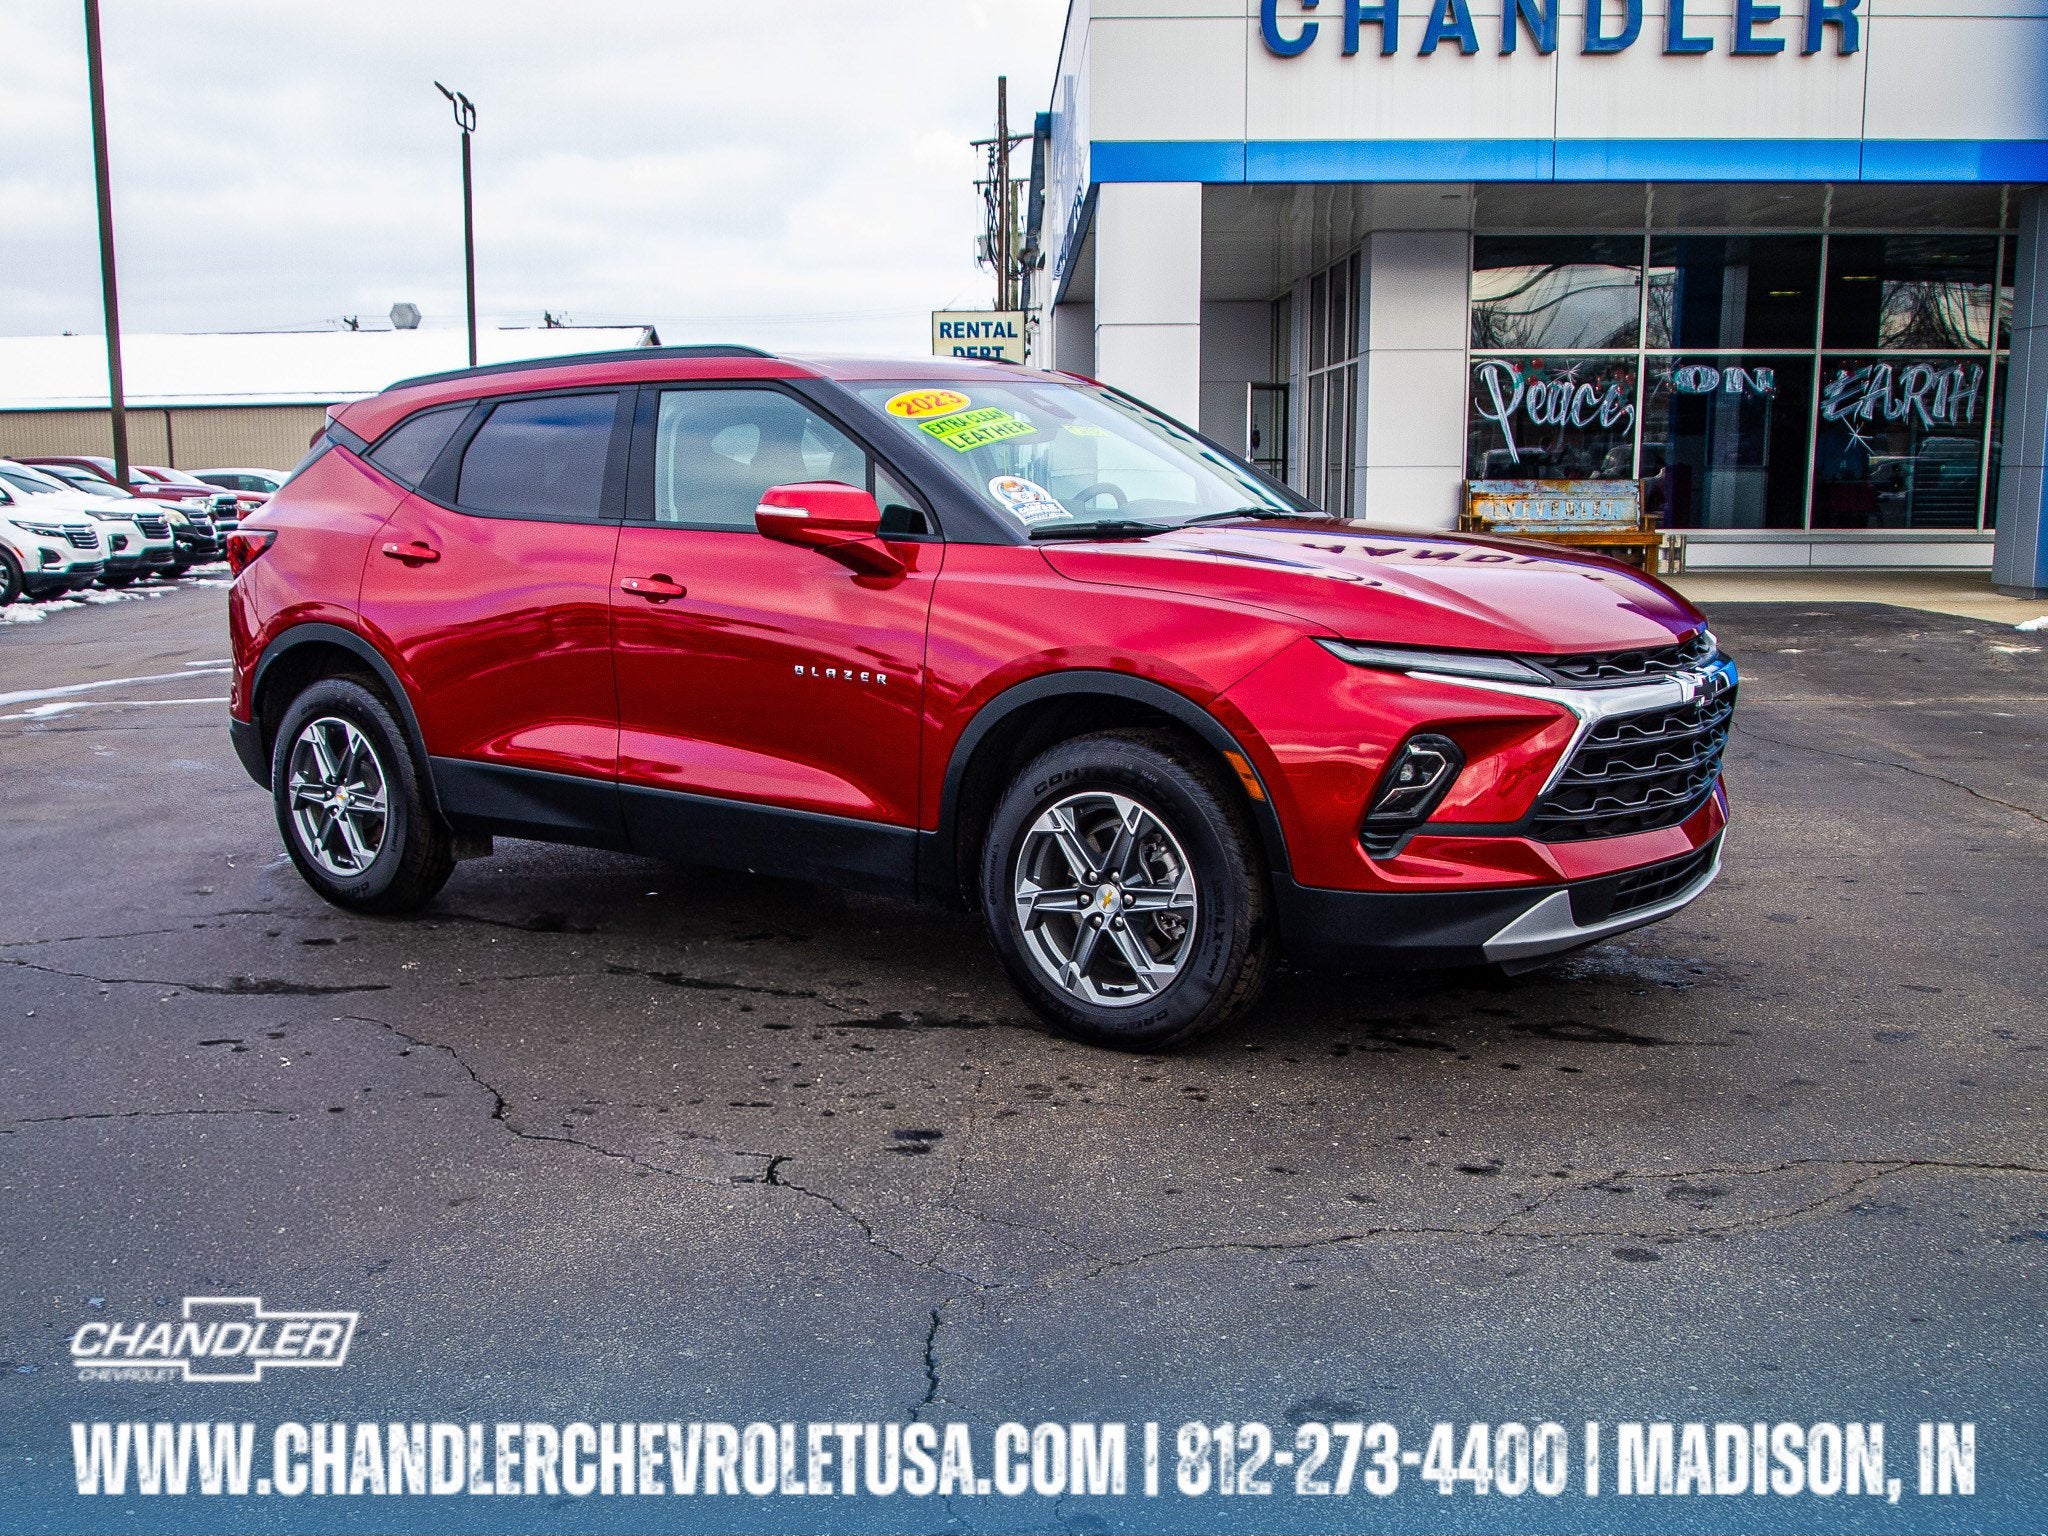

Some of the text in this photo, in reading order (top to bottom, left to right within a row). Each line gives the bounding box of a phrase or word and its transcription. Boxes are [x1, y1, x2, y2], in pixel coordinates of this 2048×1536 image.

[1259, 0, 1861, 56] CHANDLER
[940, 321, 1018, 338] RENTAL
[896, 391, 962, 416] 2023
[1820, 362, 1984, 432] EARTH
[924, 409, 1005, 435] EXTRA CLEAN
[947, 421, 1029, 448] LEATHER
[794, 664, 887, 686] BLAZER
